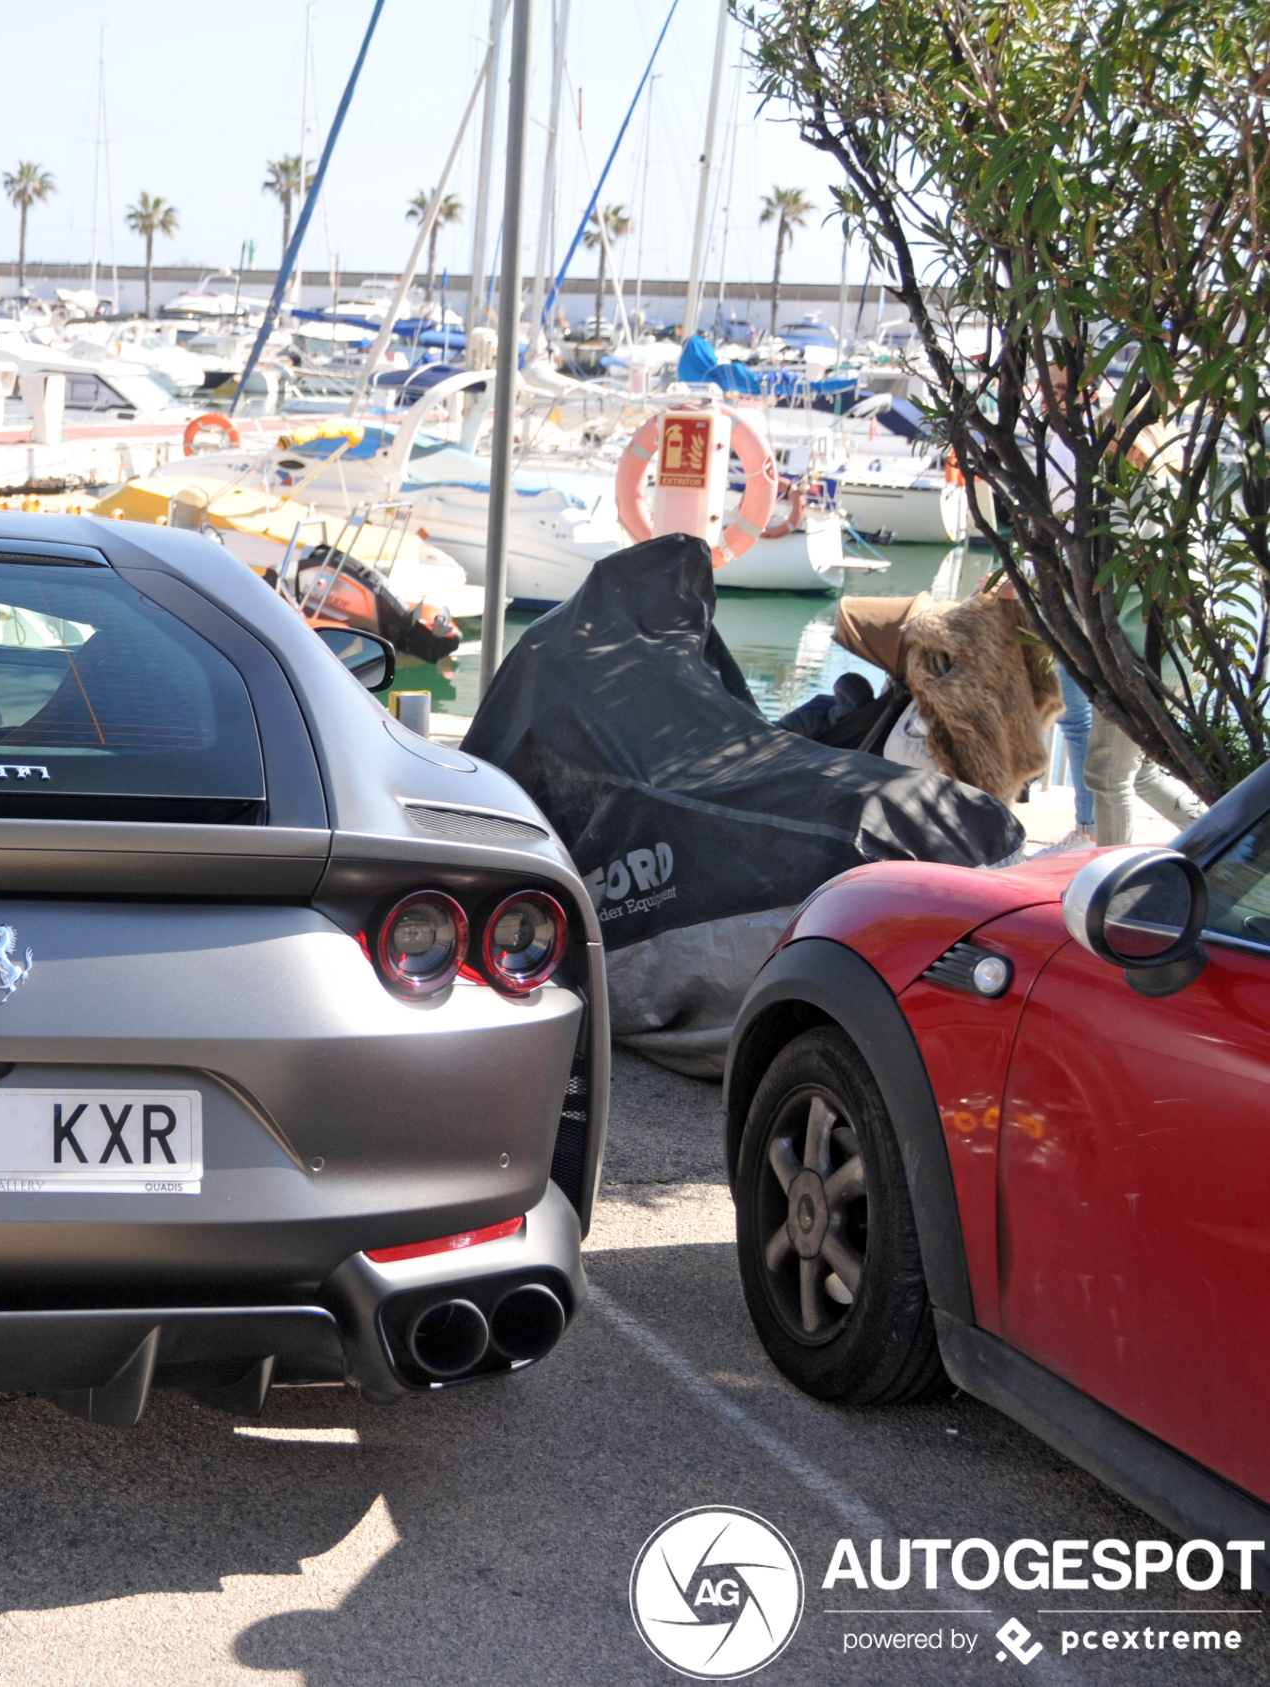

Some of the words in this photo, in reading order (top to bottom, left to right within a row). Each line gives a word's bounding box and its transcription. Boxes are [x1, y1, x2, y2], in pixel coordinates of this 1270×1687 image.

[662, 477, 702, 486] EXTINTOR
[53, 1103, 177, 1164] KXR
[145, 1183, 183, 1192] QUADIS
